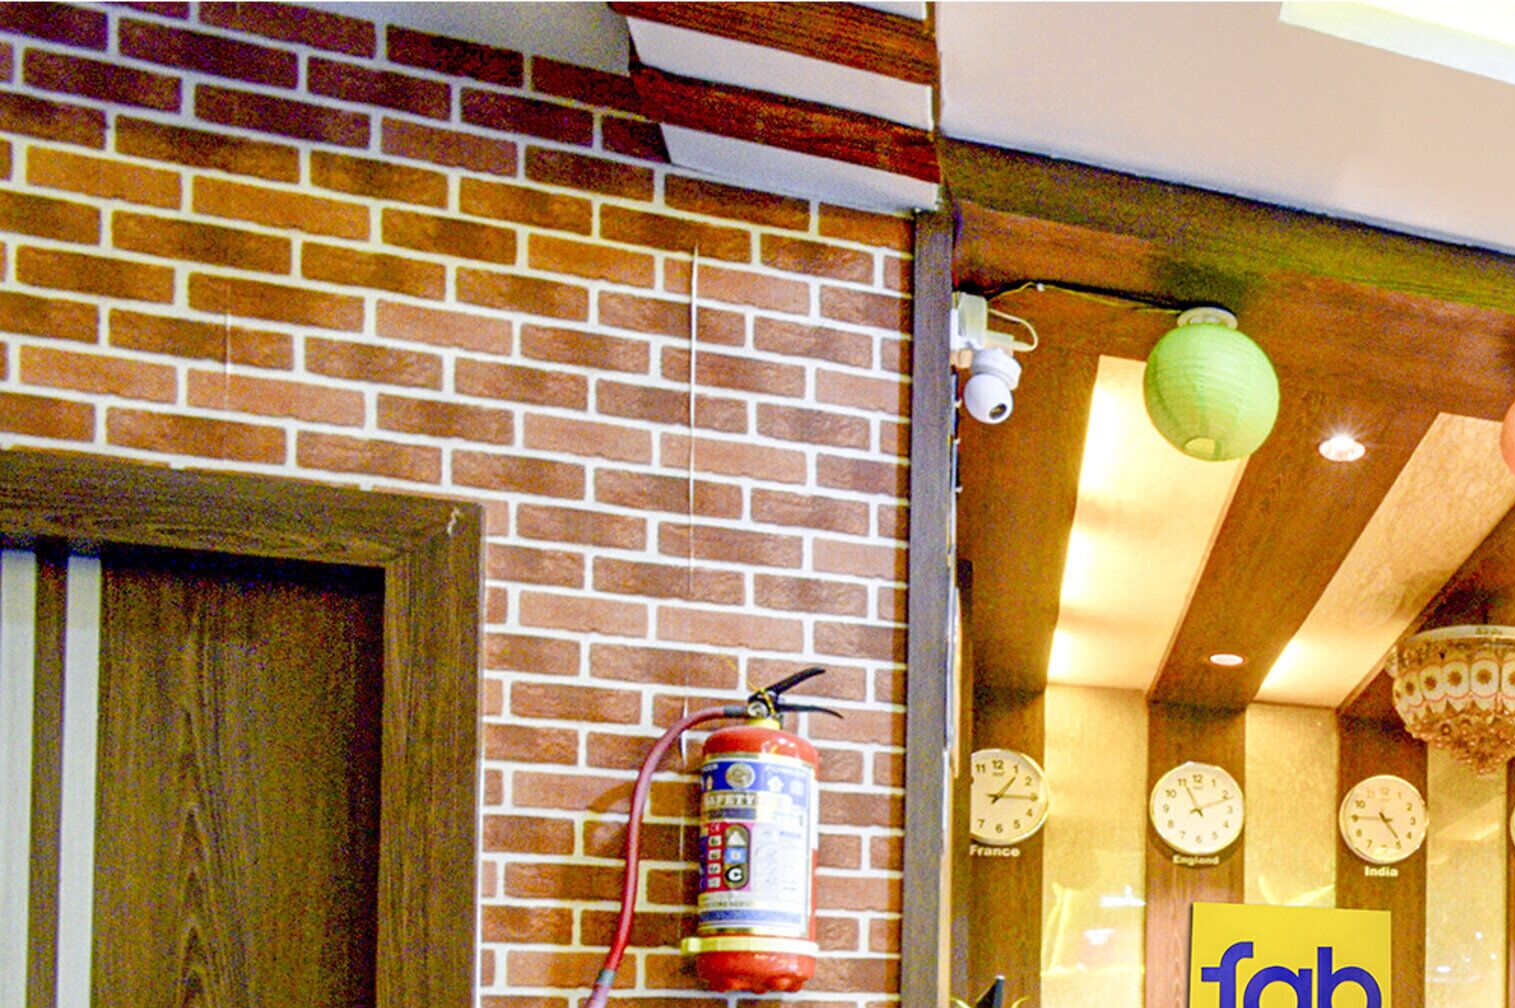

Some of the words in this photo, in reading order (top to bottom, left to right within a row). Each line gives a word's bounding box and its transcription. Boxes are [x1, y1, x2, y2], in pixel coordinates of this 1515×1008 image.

[976, 764, 986, 773] 11
[992, 760, 1004, 770] 12
[1178, 778, 1187, 787] 11
[1193, 774, 1204, 783] 12
[1165, 789, 1177, 798] 10
[1355, 800, 1366, 809] 10
[969, 844, 1021, 857] France
[1173, 854, 1220, 866] England
[1364, 865, 1399, 877] India
